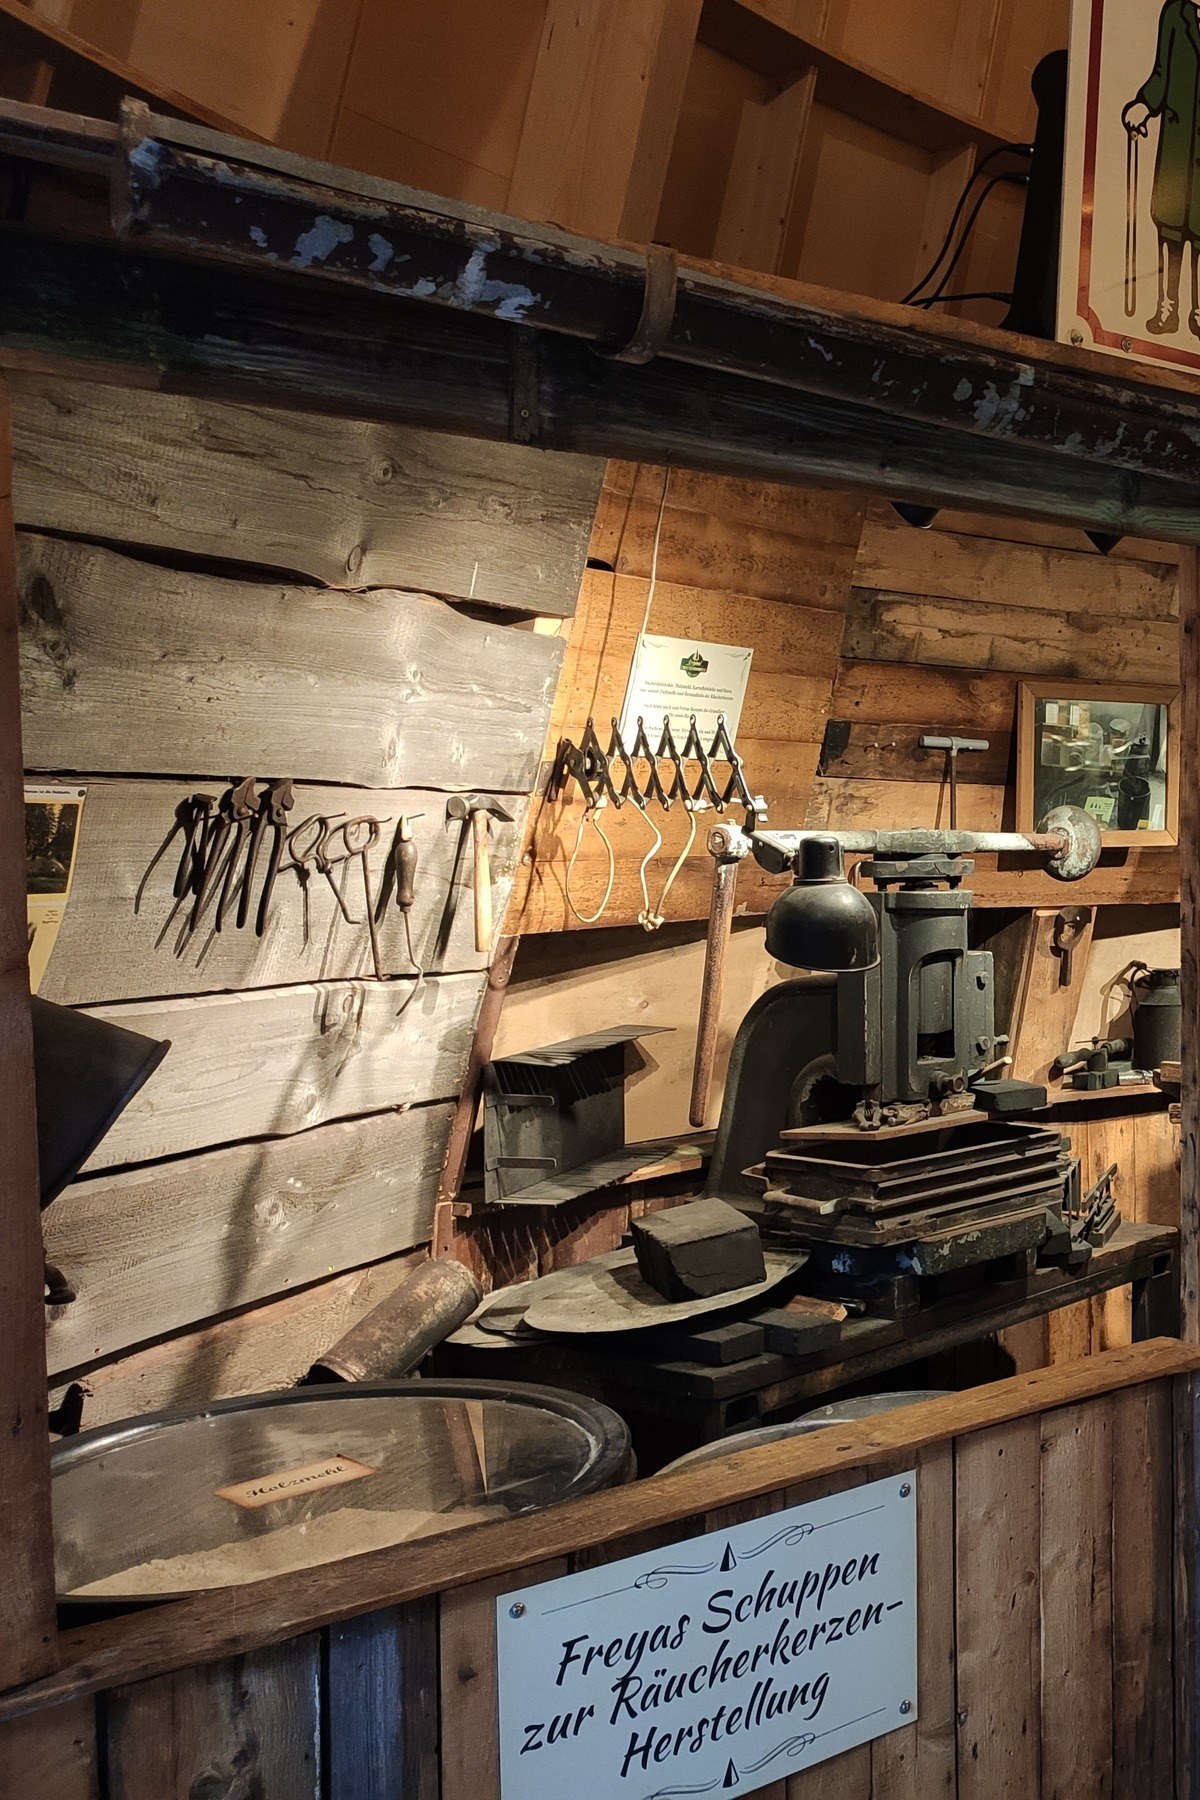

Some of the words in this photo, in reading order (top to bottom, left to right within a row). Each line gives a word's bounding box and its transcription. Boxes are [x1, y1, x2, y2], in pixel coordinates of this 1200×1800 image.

[246, 1466, 347, 1498] Holzmehl
[519, 1703, 595, 1755] zur
[609, 1600, 904, 1726] Räucherkerzen-
[555, 1613, 690, 1687] Freyas
[702, 1552, 881, 1634] Schuppen
[619, 1672, 831, 1778] Herstellung
